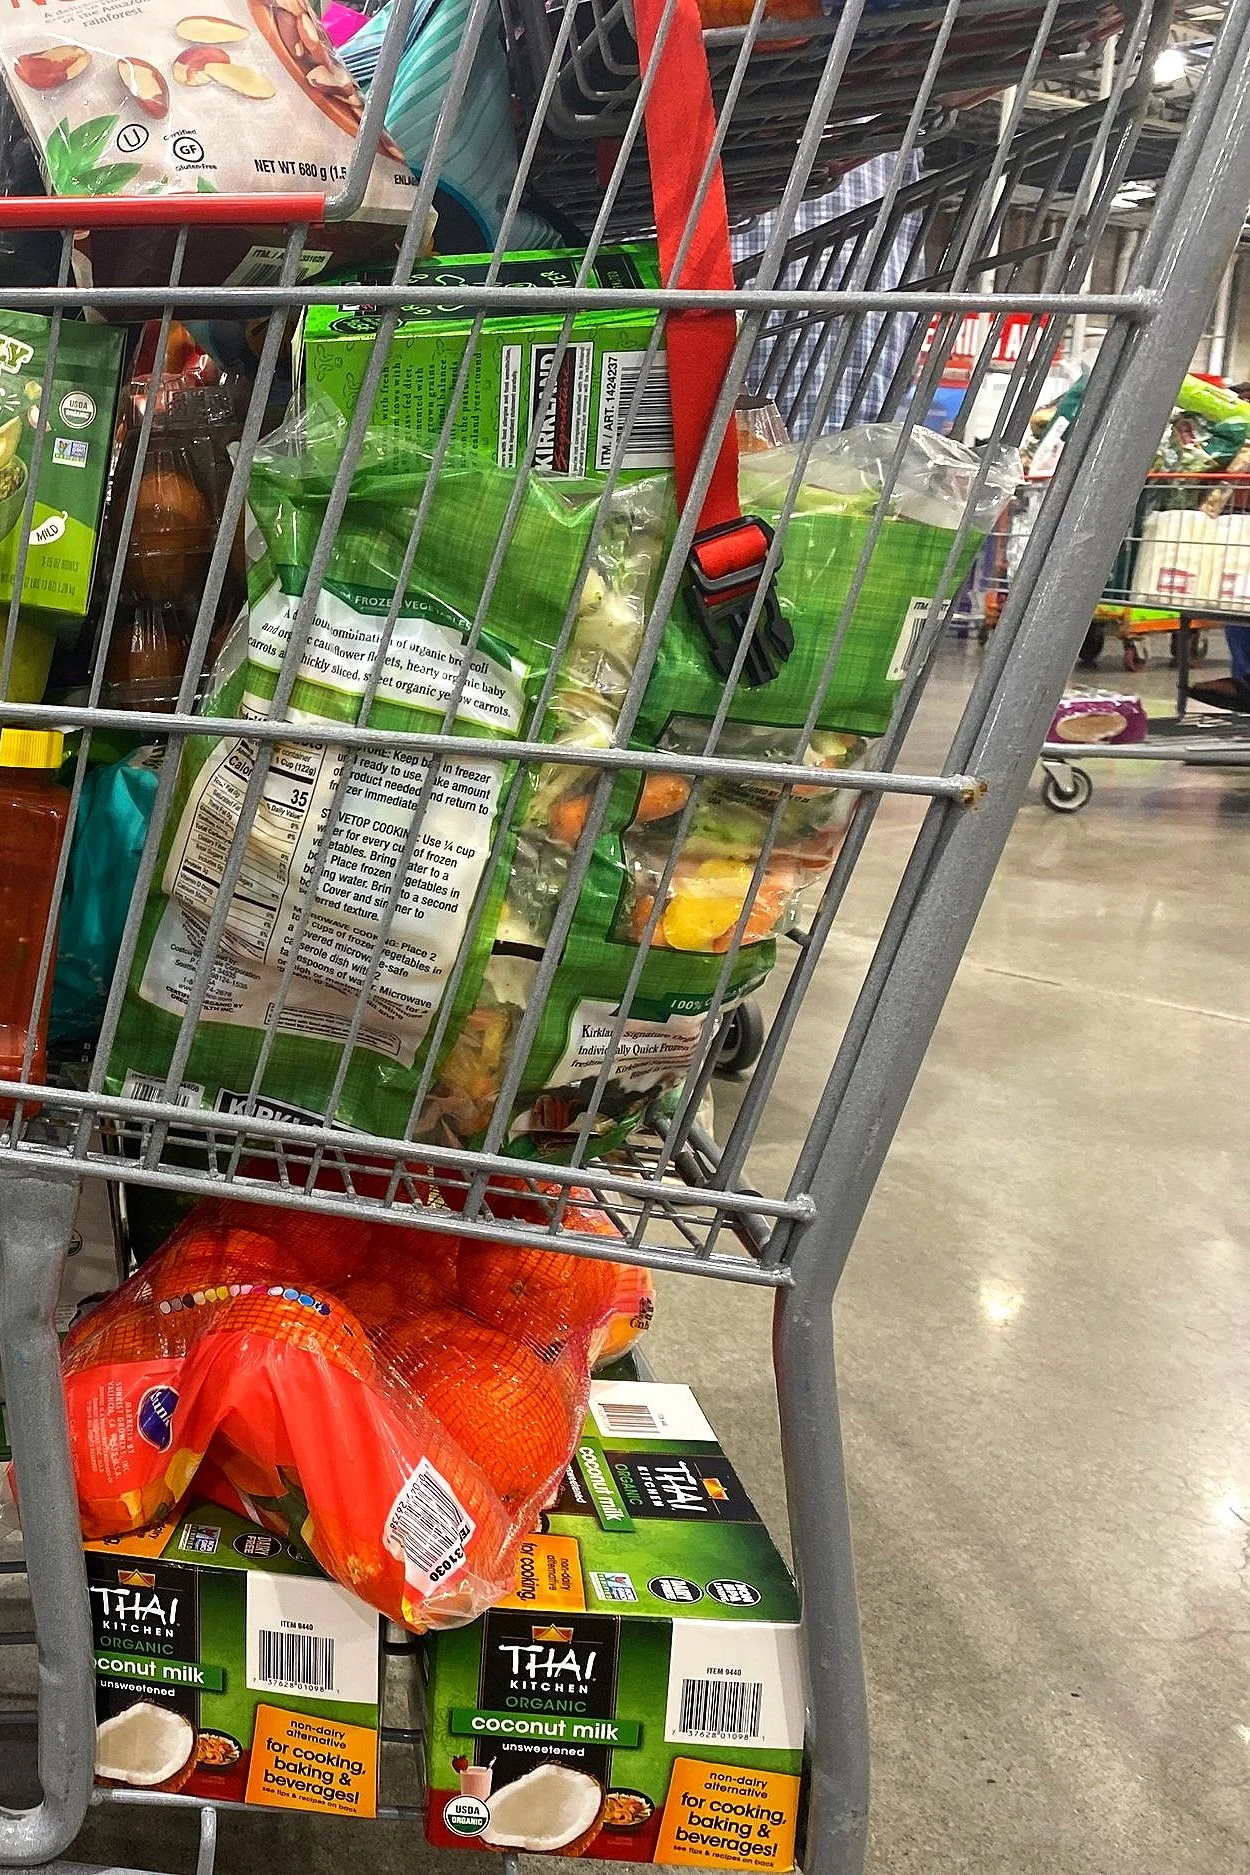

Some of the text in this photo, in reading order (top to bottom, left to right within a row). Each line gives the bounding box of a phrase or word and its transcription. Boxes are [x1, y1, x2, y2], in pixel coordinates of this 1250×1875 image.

[83, 7, 143, 27] rainforest
[180, 145, 197, 155] GF
[255, 159, 275, 173] NET
[278, 160, 296, 175] WT
[299, 163, 317, 177] 680
[320, 167, 326, 181] g
[381, 367, 389, 393] fresh
[70, 400, 88, 409] USDA
[427, 365, 436, 433] grown grains
[604, 357, 617, 431] ART. 1424237
[555, 351, 571, 470] Signature
[36, 524, 58, 542] MILD
[262, 622, 506, 698] and hearty baby
[397, 640, 489, 674] of organic brocoli
[248, 636, 510, 718] carrots sliced, organic carrots.
[393, 750, 491, 784] Keep in freezer
[359, 758, 491, 800] ready to use. amount
[290, 789, 309, 807] 35
[384, 778, 489, 815] needed return to
[346, 828, 458, 868] for every of frozen
[422, 834, 476, 859] Use cup
[330, 855, 392, 879] Place frozen
[370, 851, 442, 878] Bring to
[339, 873, 368, 889] water.
[322, 882, 372, 907] Cover and
[421, 896, 459, 913] second
[343, 903, 379, 921] texture.
[379, 986, 431, 1008] Microwave
[670, 999, 701, 1010] 100%
[633, 1043, 690, 1056] Quick Frozen
[578, 1446, 614, 1494] coconut
[614, 1464, 642, 1506] ORGANIC
[654, 1460, 708, 1512] THAI
[90, 1587, 179, 1624] THAI
[103, 1621, 174, 1638] KITCHEN
[280, 1620, 296, 1630] ITEM
[100, 1635, 174, 1655] ORGANIC
[498, 1643, 598, 1682] THAI
[706, 1667, 723, 1676] ITEM
[162, 1666, 205, 1684] milk
[100, 1680, 175, 1697] unsweetened
[510, 1680, 589, 1694] KITCHEN
[506, 1696, 587, 1713] ORGANIC
[286, 1728, 347, 1749] alternative
[290, 1719, 346, 1738] non-dairy
[471, 1715, 620, 1741] coconut milk
[688, 1730, 717, 1739] 37628
[266, 1737, 367, 1776] for cooking,
[502, 1741, 585, 1757] unsweetened
[274, 1756, 351, 1786] baking &
[709, 1771, 768, 1790] non-dairy
[264, 1769, 360, 1804] beverages!
[704, 1780, 768, 1799] alternative
[455, 1804, 480, 1816] USDA
[681, 1791, 787, 1826] for cooking,
[451, 1816, 483, 1827] ORGANIC
[688, 1811, 771, 1839] baking &
[675, 1825, 778, 1858] beverages!
